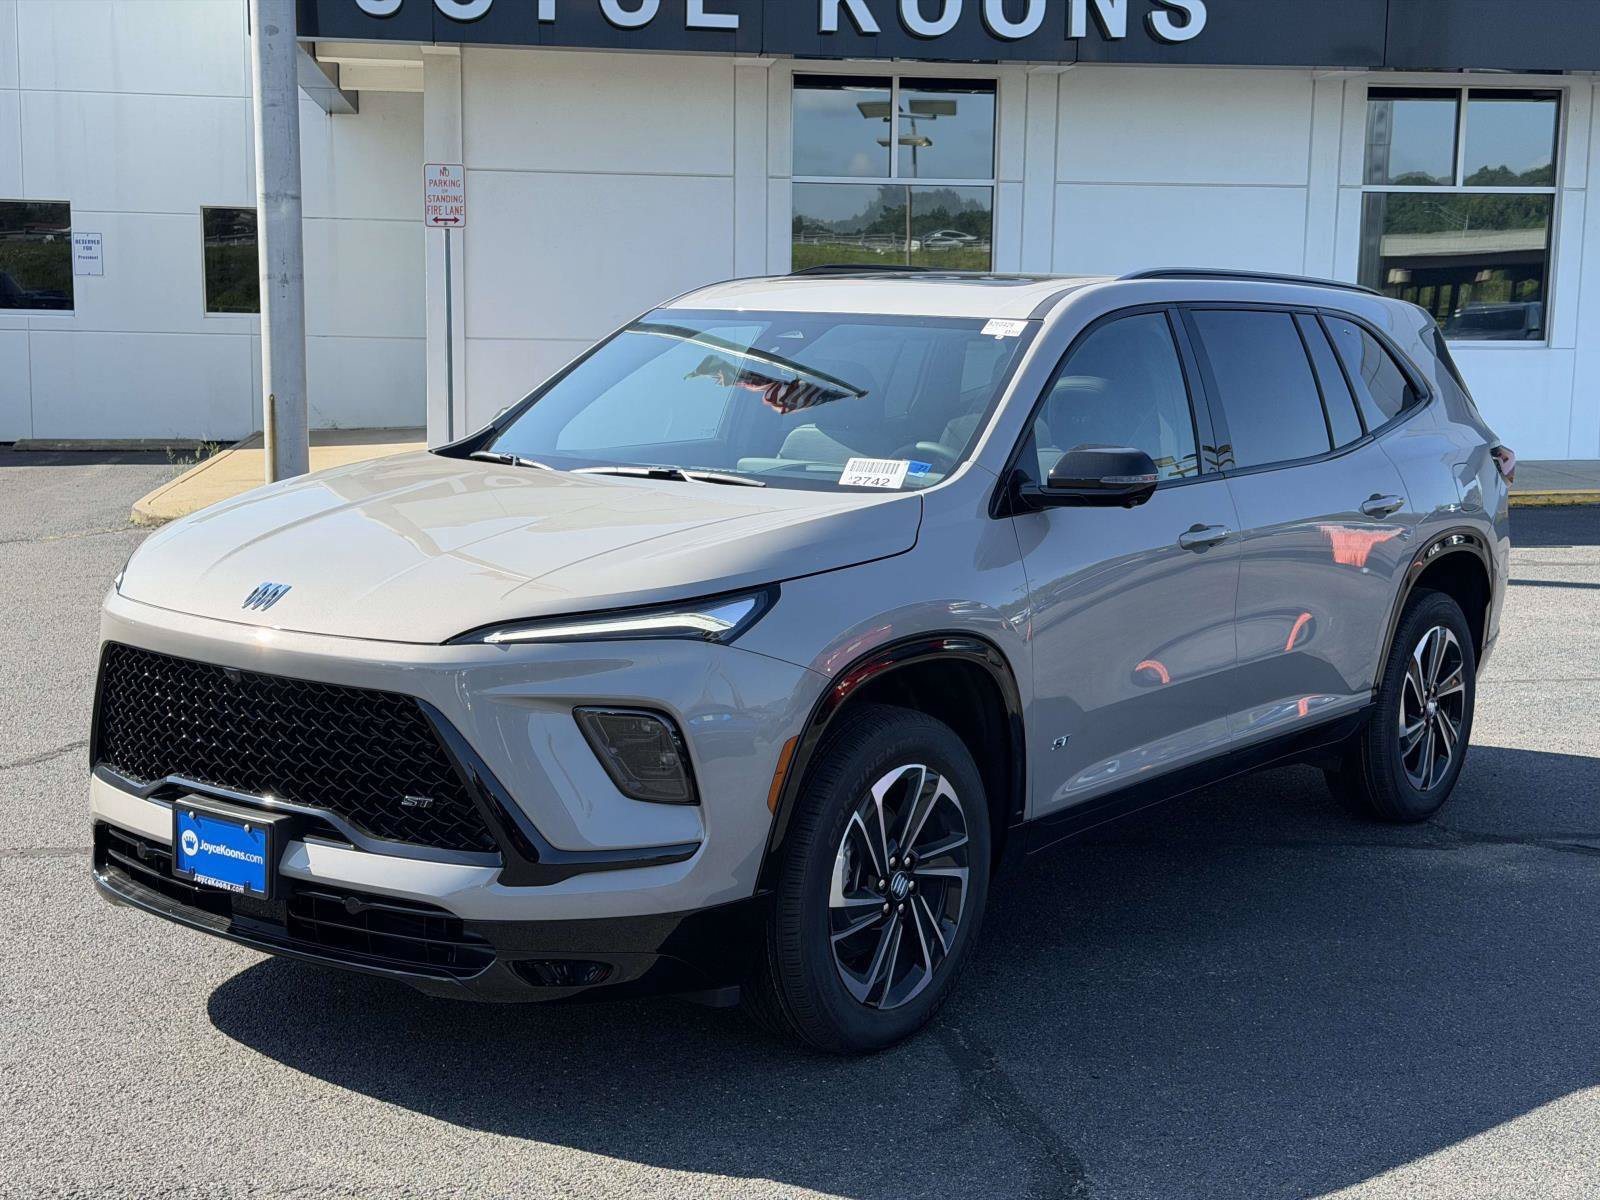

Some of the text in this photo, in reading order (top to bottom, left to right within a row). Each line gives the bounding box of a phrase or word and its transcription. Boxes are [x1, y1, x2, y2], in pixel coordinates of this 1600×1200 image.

[439, 167, 450, 177] NO
[428, 179, 461, 188] PARKING
[427, 194, 464, 204] STANDING
[426, 205, 465, 216] FIRE LANE
[401, 795, 434, 808] ST
[199, 839, 264, 865] JoyceKoons.com
[193, 873, 246, 894] JoyceKoons.com
